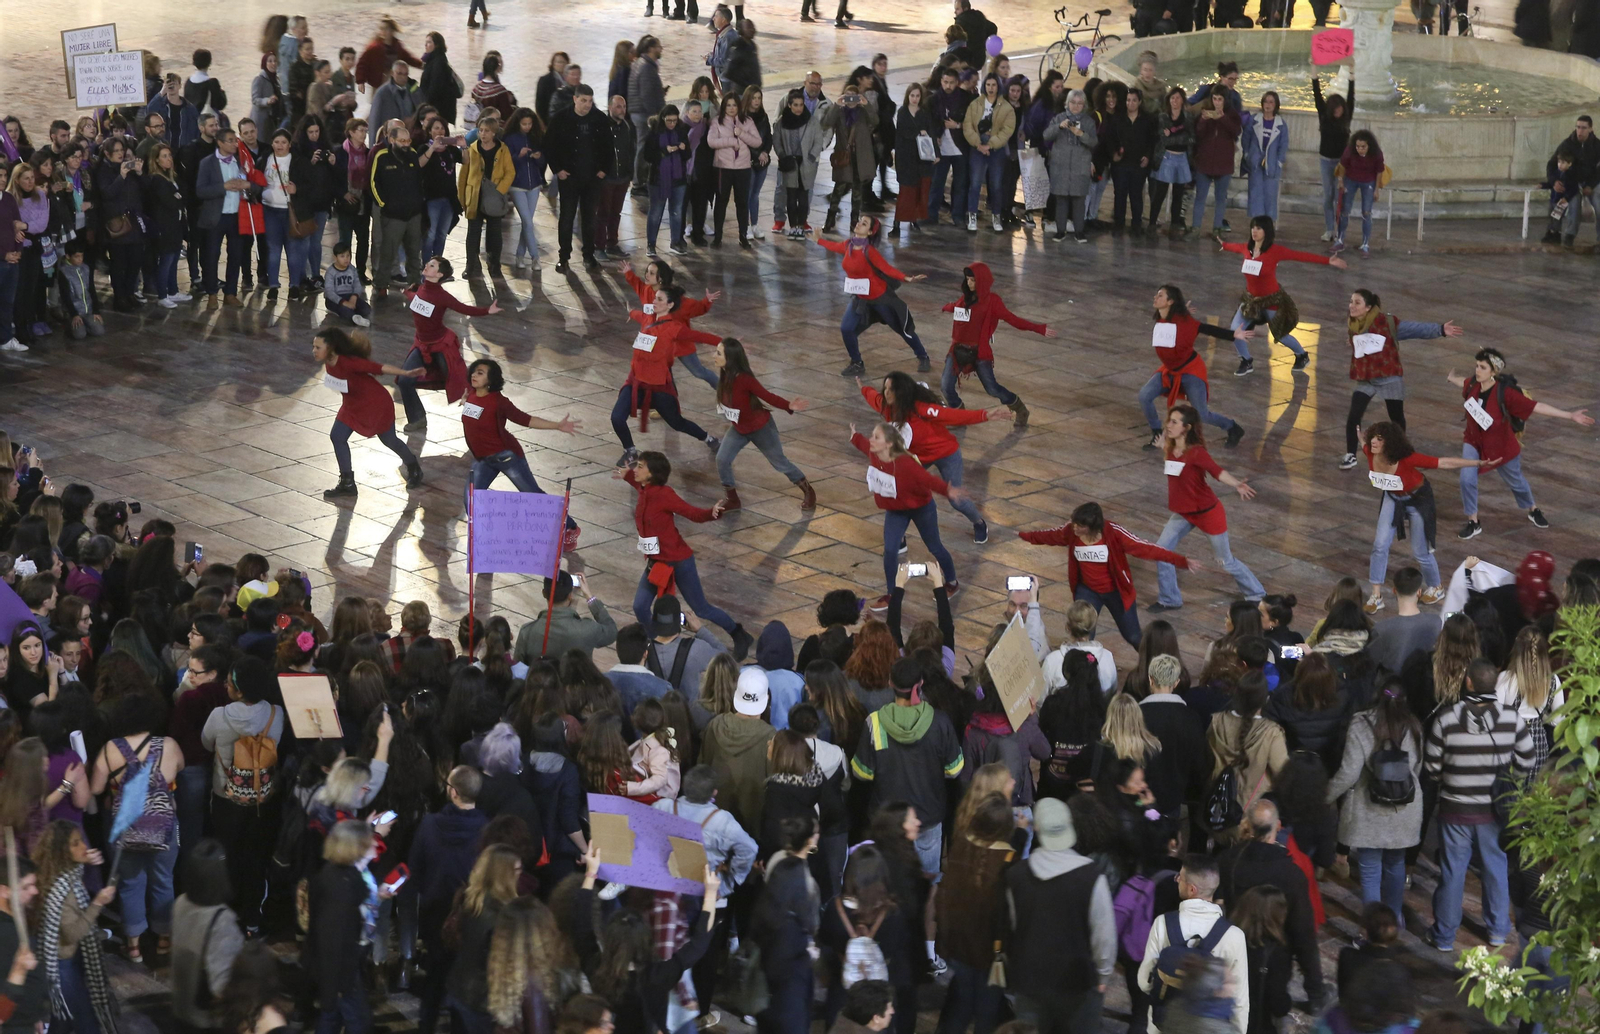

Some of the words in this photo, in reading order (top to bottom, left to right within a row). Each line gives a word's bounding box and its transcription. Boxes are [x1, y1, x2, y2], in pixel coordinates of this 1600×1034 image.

[68, 34, 77, 42] NO
[98, 28, 111, 38] UNA
[69, 43, 90, 52] MUJER
[92, 39, 112, 49] LIBRE
[87, 86, 110, 94] ELLAS
[112, 84, 136, 94] MISMAS
[337, 275, 352, 286] NYC
[927, 407, 939, 416] 2
[1468, 402, 1490, 428] JUNTAS
[1371, 476, 1398, 488] JUNTAS
[512, 510, 518, 519] el
[524, 508, 562, 522] feminism
[482, 522, 494, 532] NO
[506, 520, 550, 532] PERDONA
[1075, 550, 1106, 560] JUNTAS
